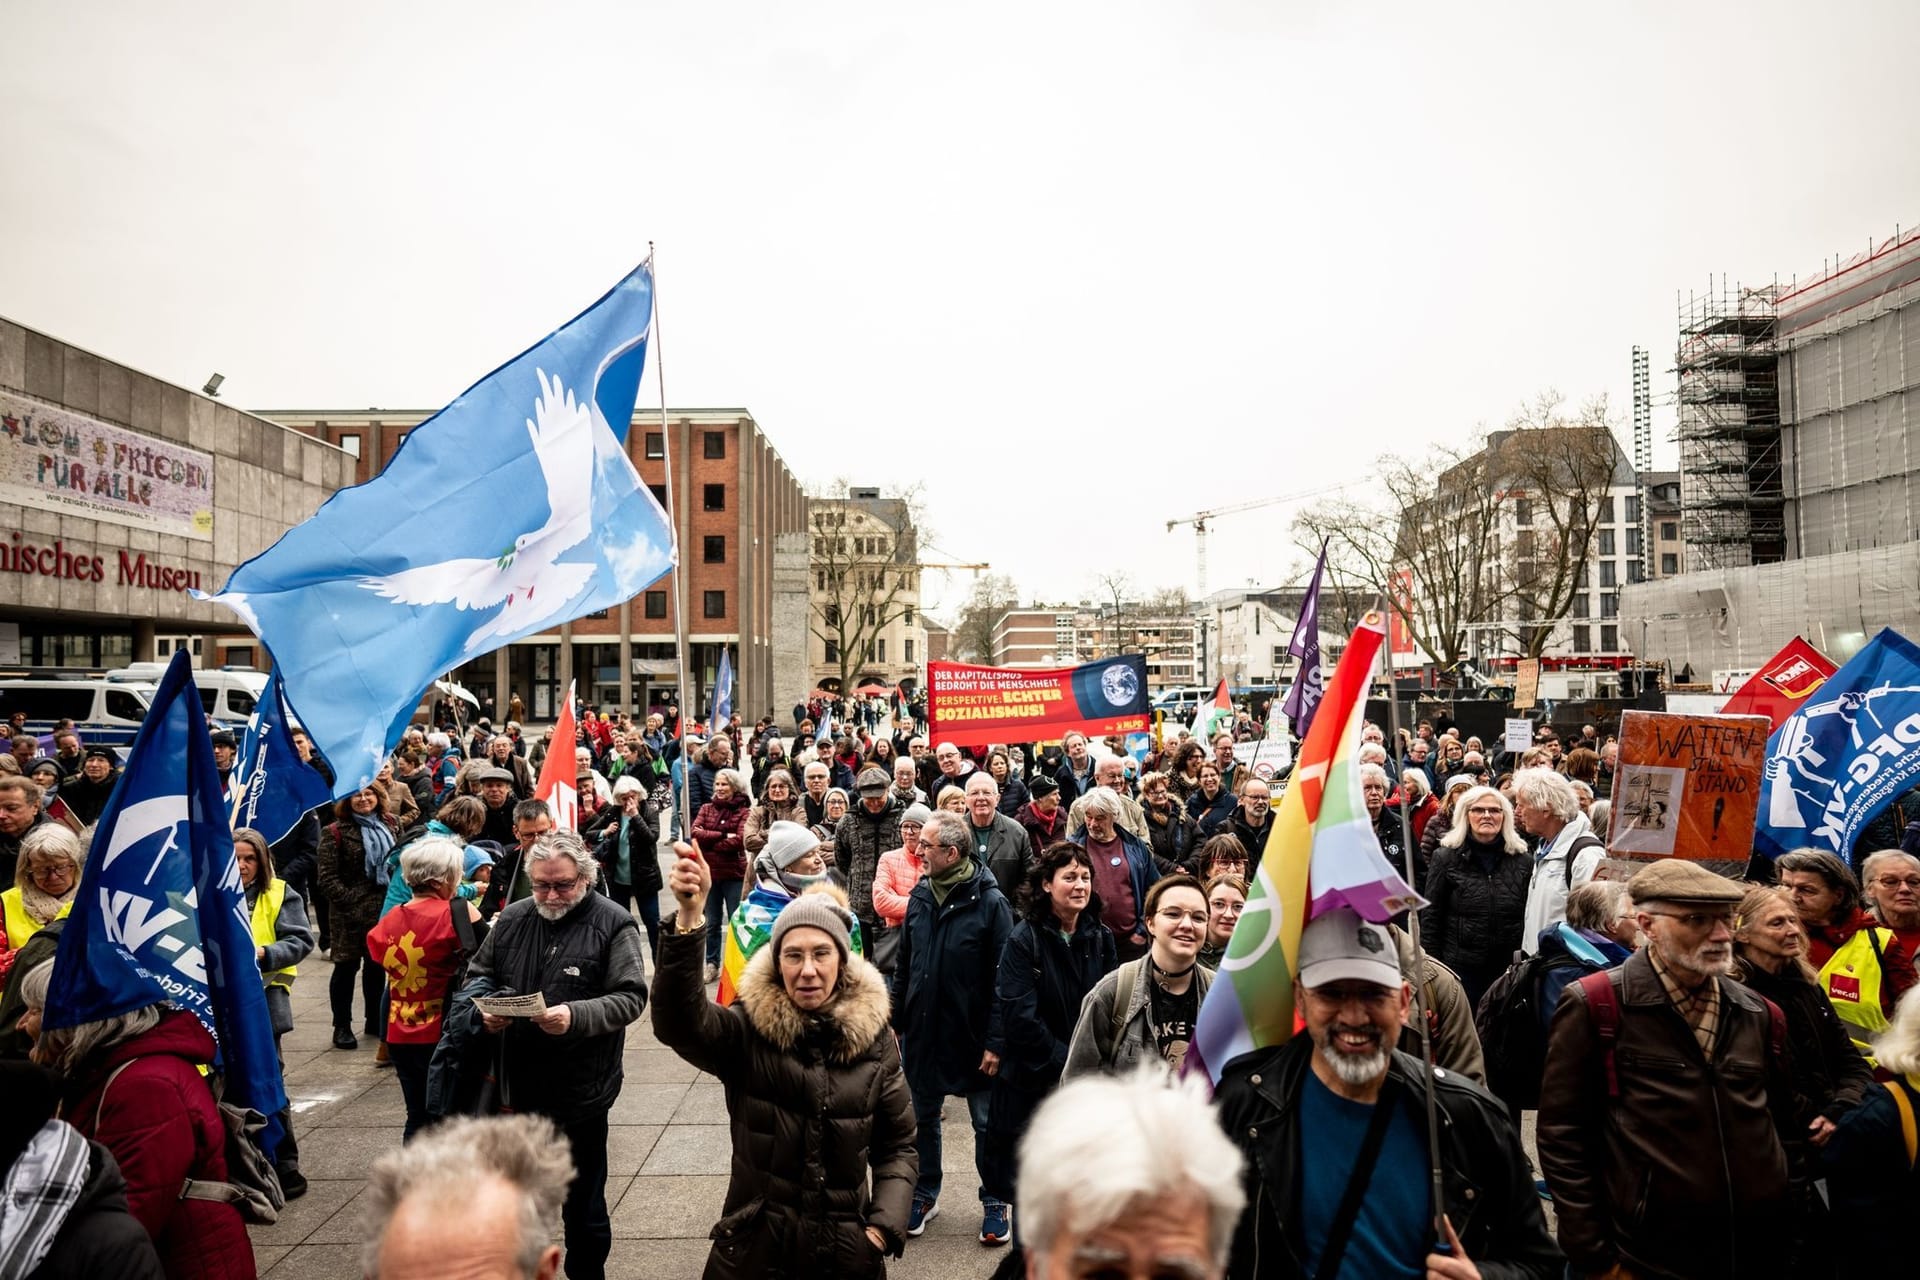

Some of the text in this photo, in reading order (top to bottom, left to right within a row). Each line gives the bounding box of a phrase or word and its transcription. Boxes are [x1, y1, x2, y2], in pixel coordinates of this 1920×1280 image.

[38, 453, 87, 493] FÜR
[46, 494, 61, 502] WIR
[63, 497, 90, 509] ZEIGEN
[934, 671, 1022, 680] DER KAPITALISMUS
[935, 678, 1061, 691] BEDROHT DIE MENSCHHEIT.
[935, 689, 1062, 705] PERSPEKTIVE: ECHTER
[935, 704, 1045, 721] SOZIALISMUS!
[1693, 775, 1748, 793] STAND
[1831, 986, 1858, 999] ver.di
